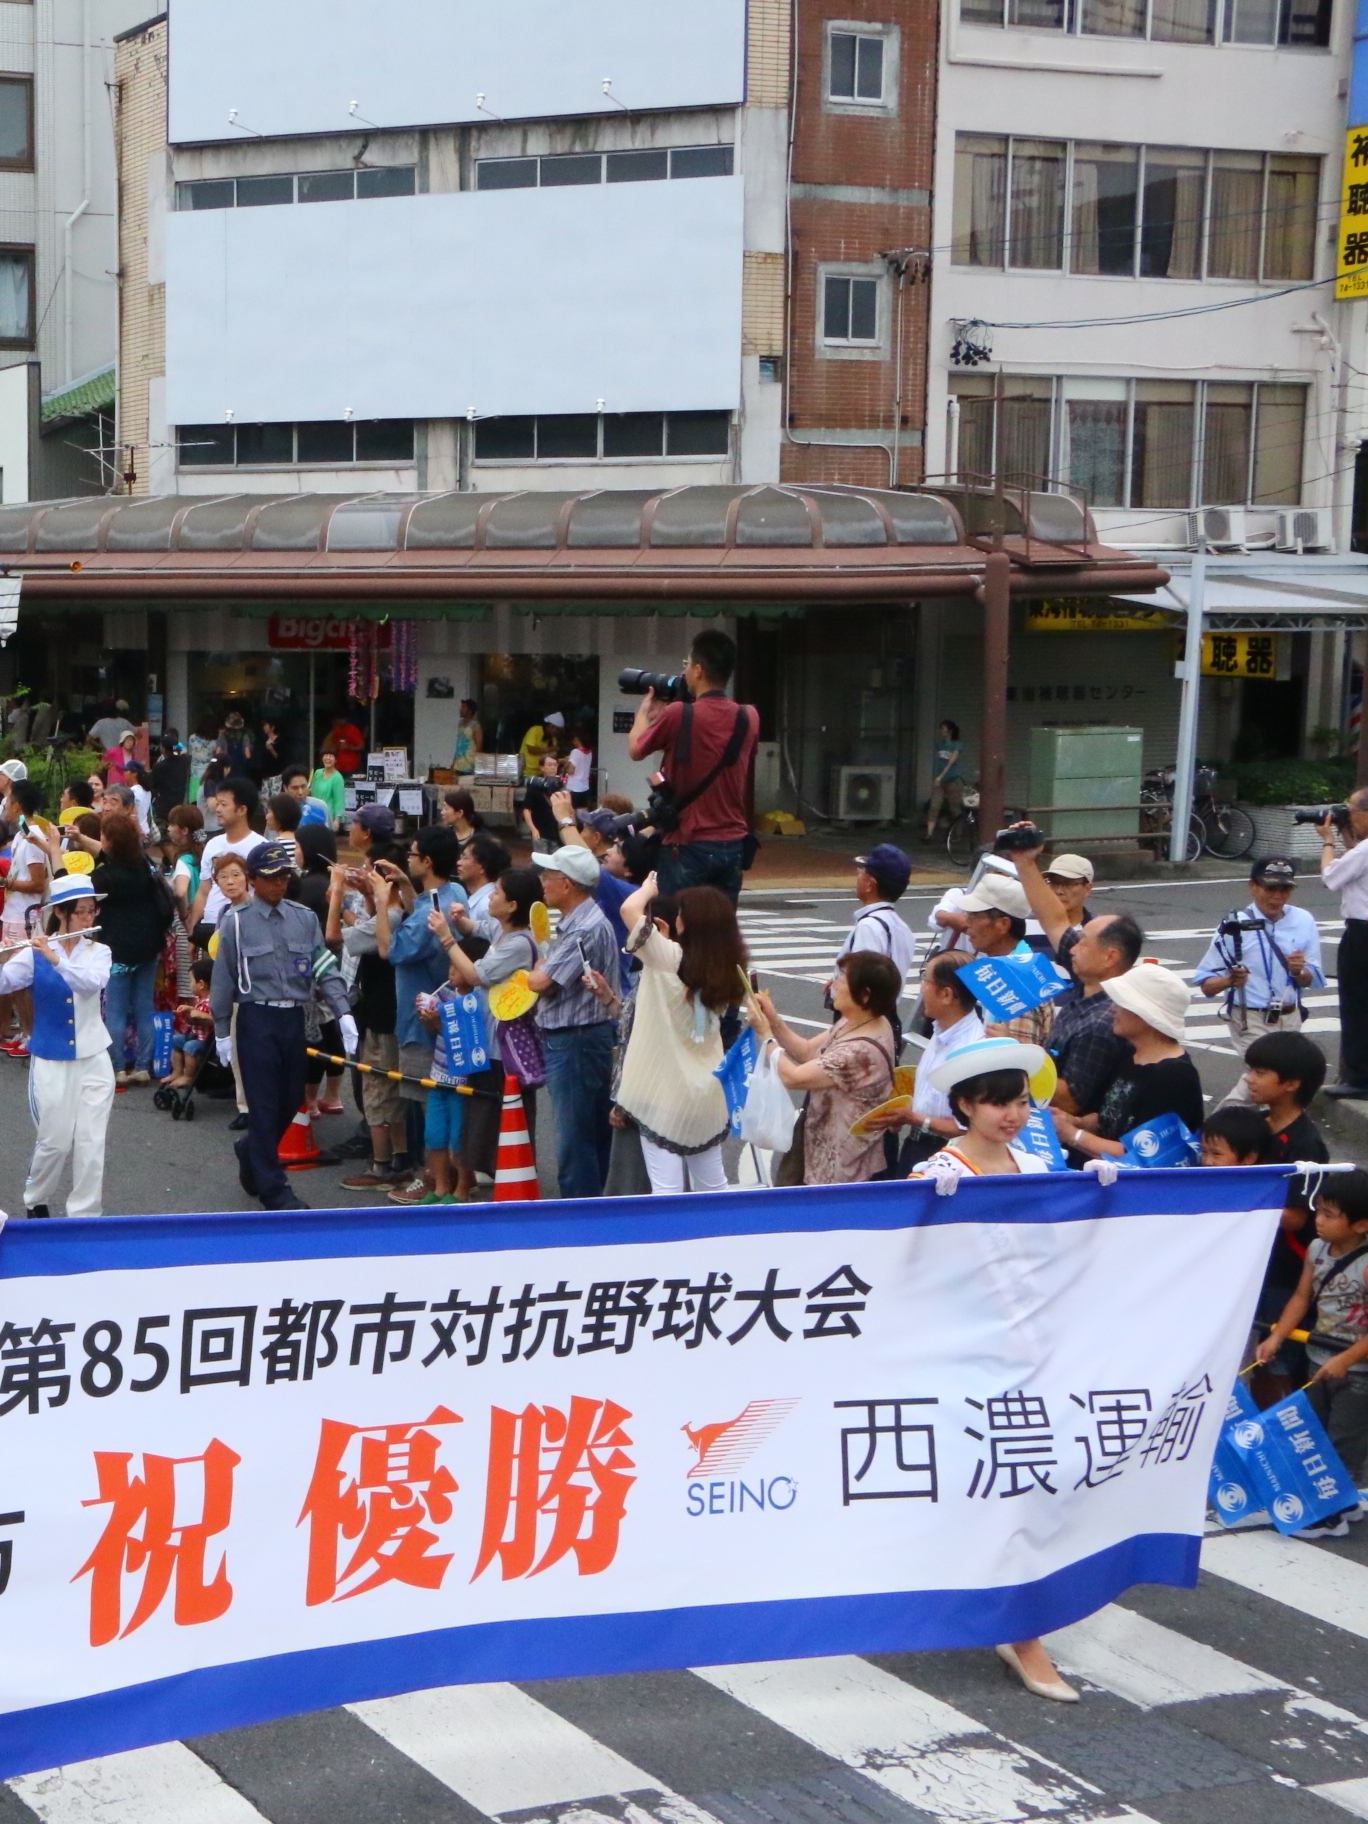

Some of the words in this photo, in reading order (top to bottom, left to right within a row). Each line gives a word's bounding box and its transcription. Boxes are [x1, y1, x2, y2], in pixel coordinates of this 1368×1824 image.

[974, 963, 1029, 1015] 毎日新聞
[833, 1373, 1216, 1507] 西濃運輸
[1255, 1450, 1283, 1493] MAINICHI
[1276, 1405, 1340, 1500] 毎日新聞
[69, 1437, 242, 1648] 祝
[295, 1394, 637, 1607] 優勝
[685, 1475, 799, 1518] SEINO
